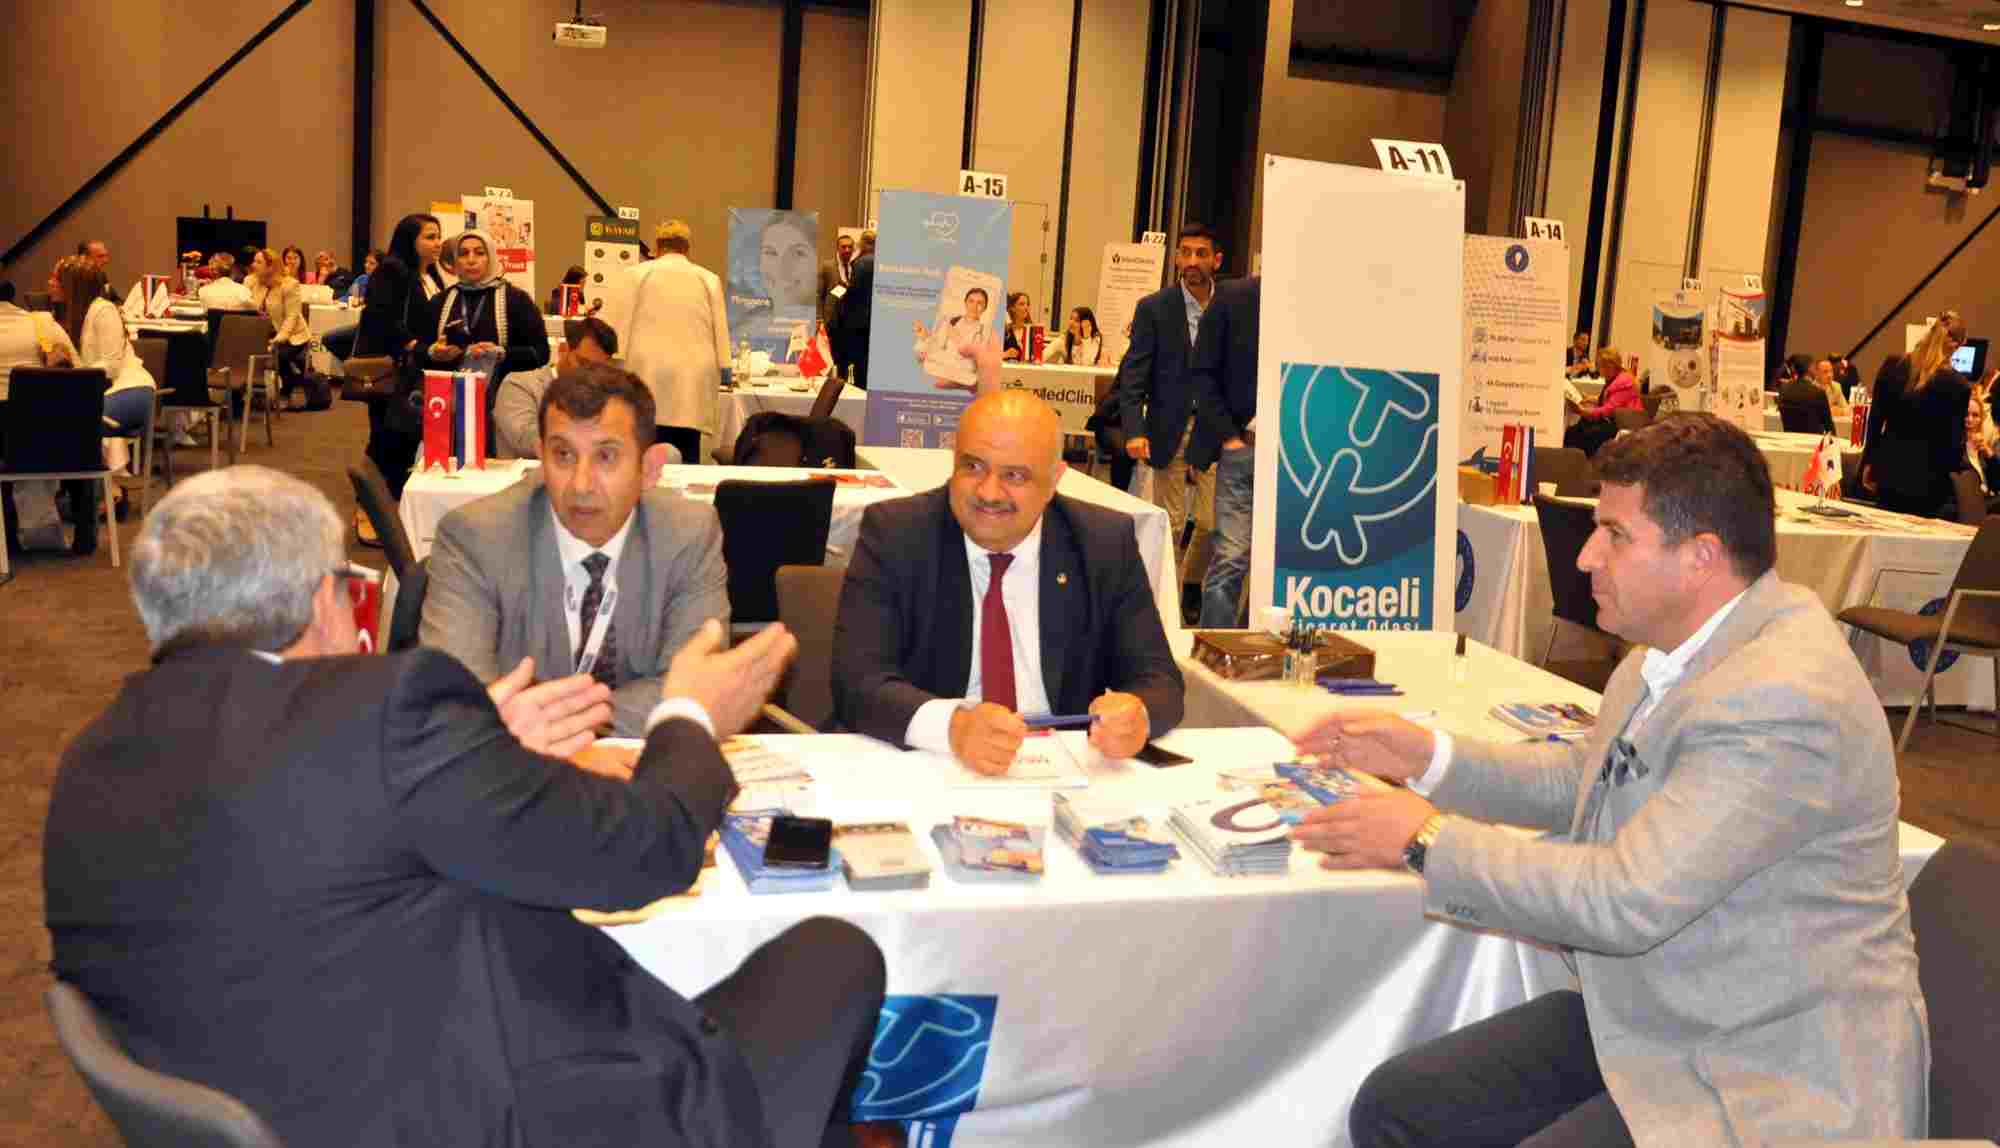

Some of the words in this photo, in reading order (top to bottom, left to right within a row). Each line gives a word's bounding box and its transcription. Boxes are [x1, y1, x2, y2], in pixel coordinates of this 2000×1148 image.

[1388, 145, 1444, 175] A-11
[963, 175, 1004, 197] A-15
[1530, 221, 1562, 241] A-14
[1032, 386, 1097, 405] MedClin
[1285, 575, 1421, 619] Kocaeli
